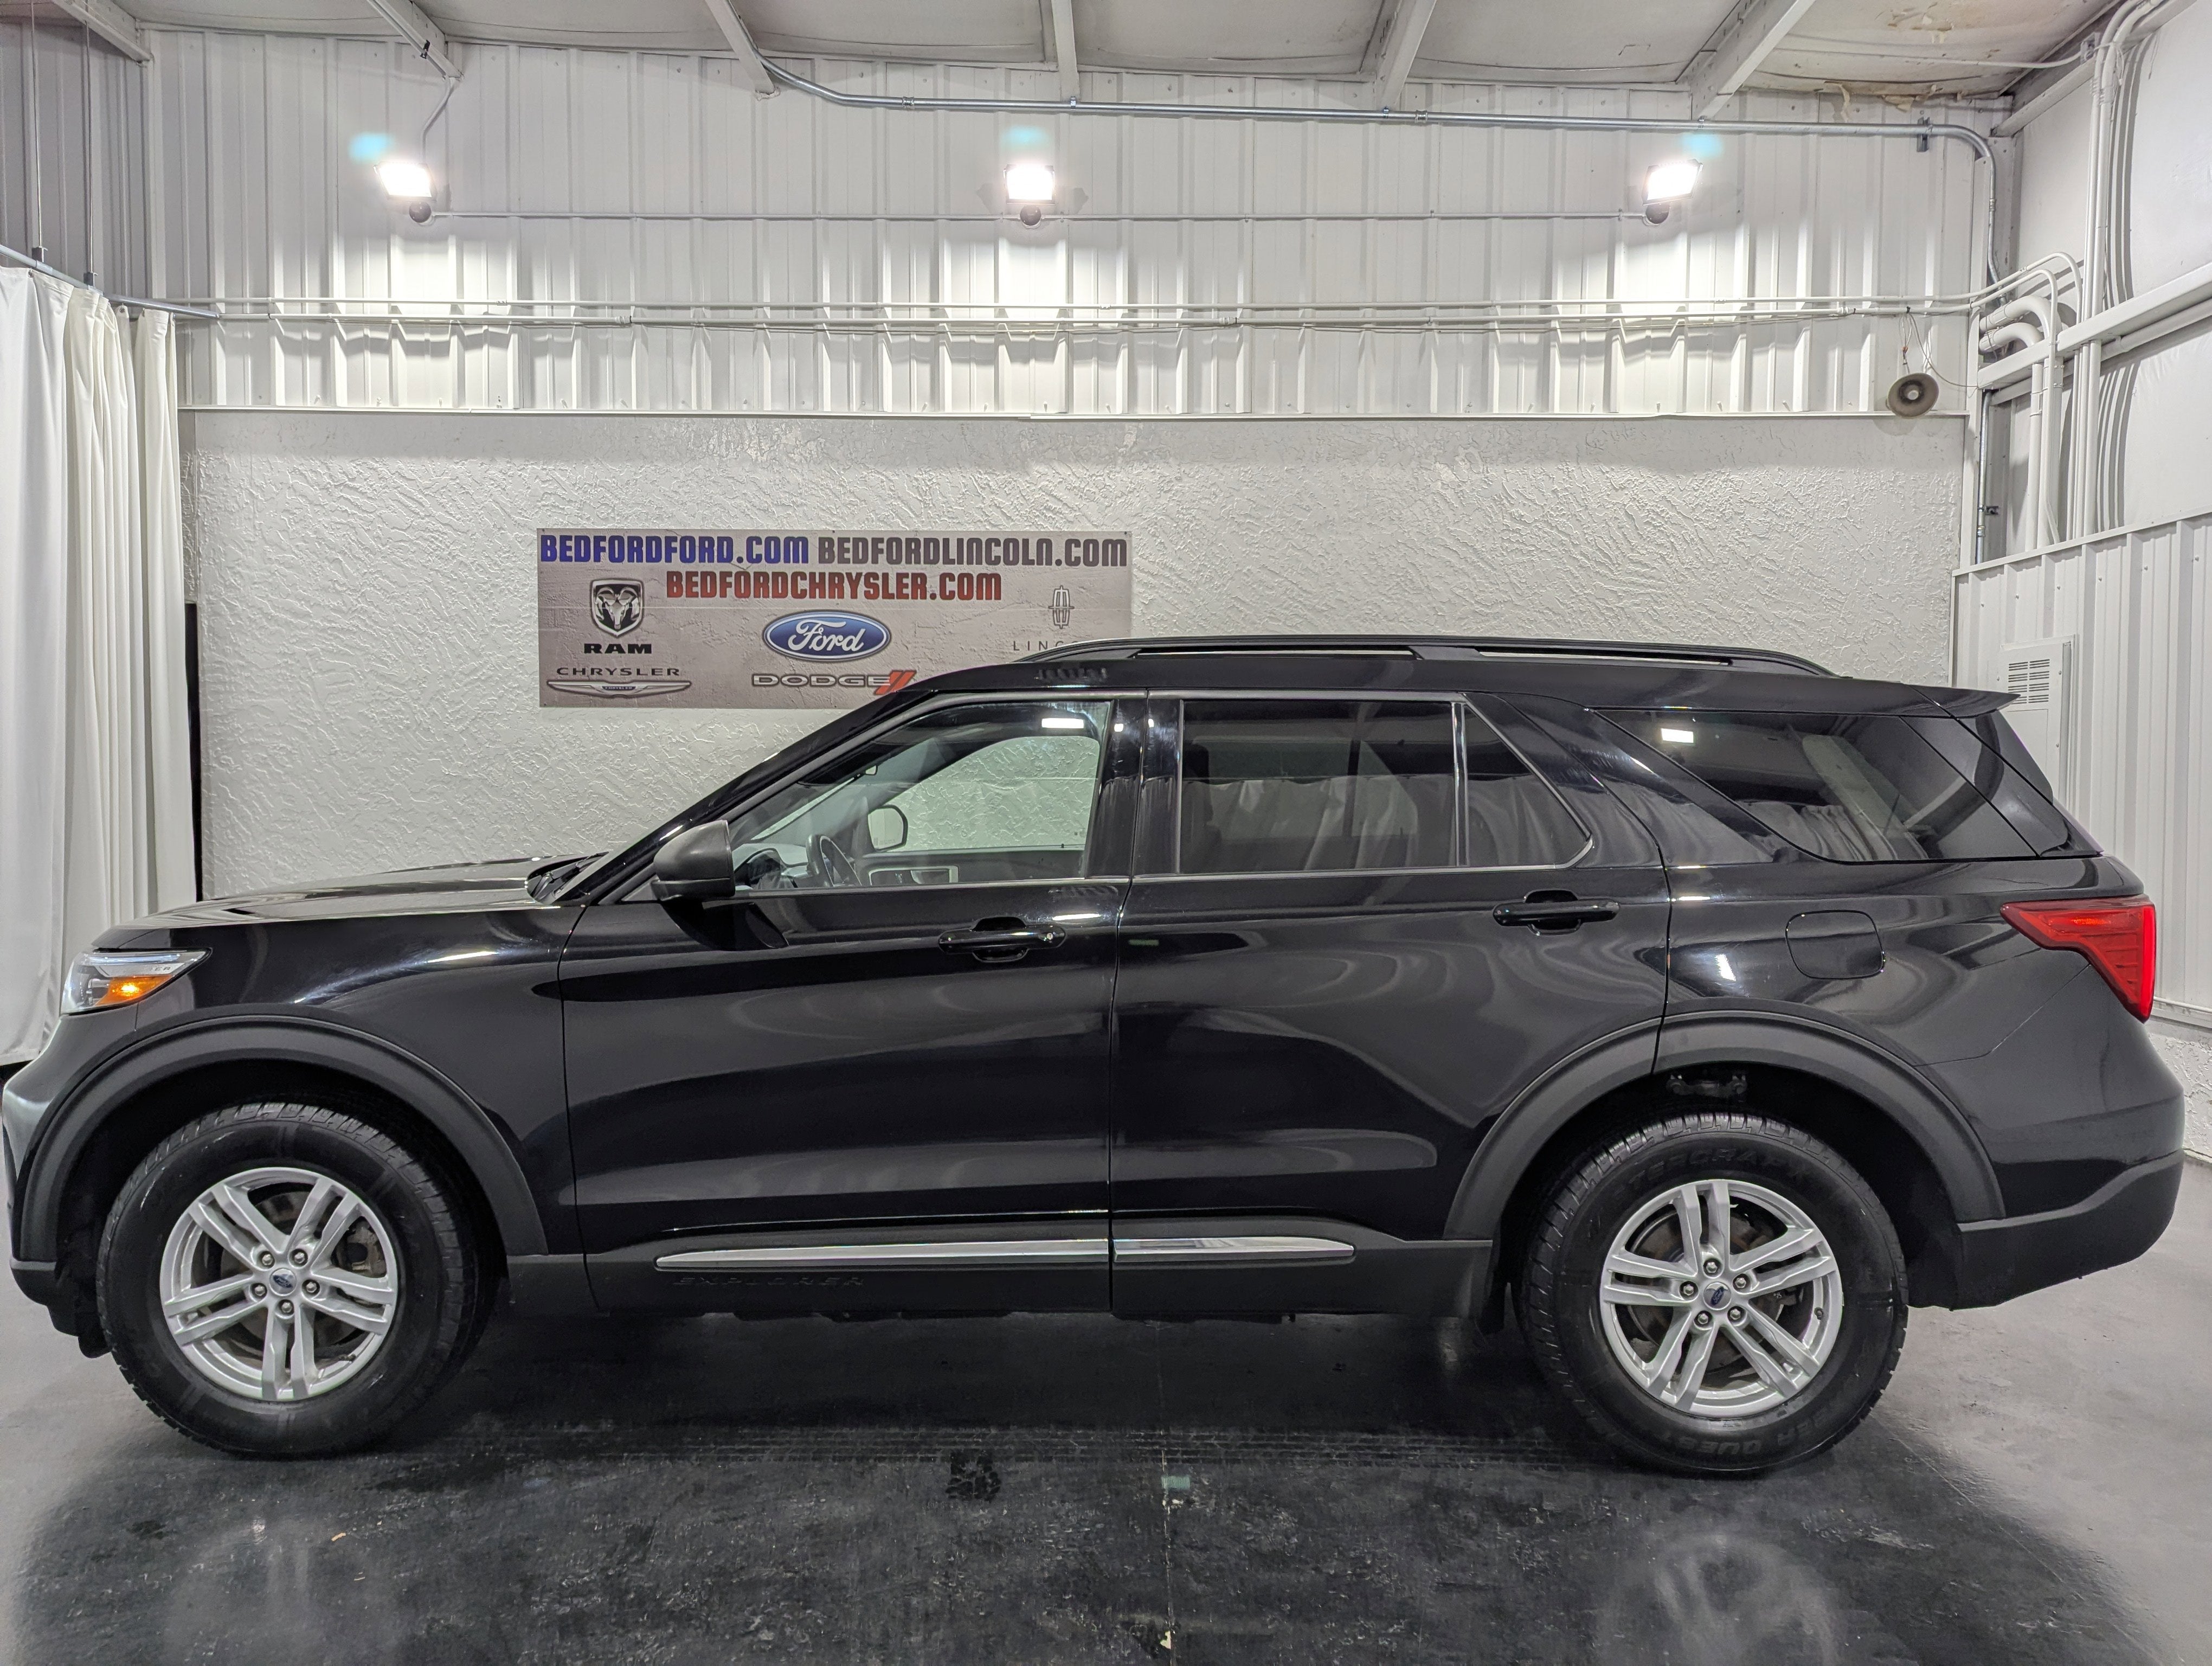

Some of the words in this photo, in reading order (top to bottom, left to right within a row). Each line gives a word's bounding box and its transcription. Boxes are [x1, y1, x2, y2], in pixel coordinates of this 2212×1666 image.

[541, 535, 809, 563] BEDFORDFORD.COM
[818, 537, 1127, 567] BEDFORDLINCOLN.COM
[666, 571, 1002, 600] BEDFORDCHRYSLER.COM
[788, 619, 866, 651] Ford
[583, 643, 652, 654] RAM
[1013, 640, 1078, 651] LINC
[556, 667, 680, 676] CHRYSLER
[752, 674, 892, 687] DODGE
